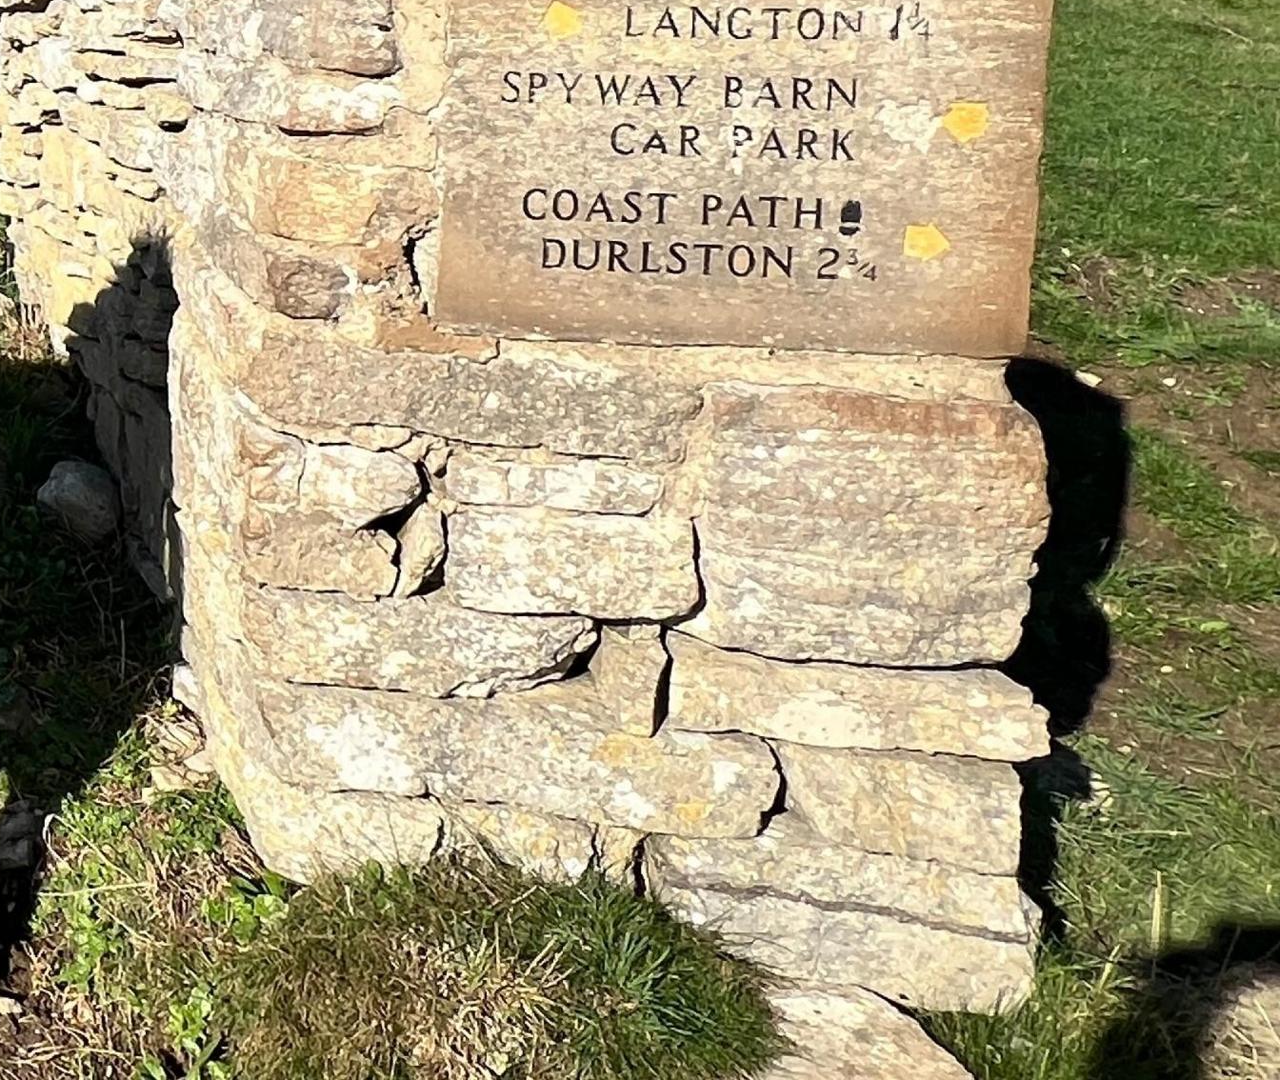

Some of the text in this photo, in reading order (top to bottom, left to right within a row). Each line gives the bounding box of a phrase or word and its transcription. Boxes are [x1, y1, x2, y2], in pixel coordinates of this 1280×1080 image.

[625, 6, 863, 40] LANGTON
[501, 71, 857, 111] SPYWAY BARN
[610, 123, 854, 161] CAR PARK
[522, 188, 823, 230] COAST PATH
[542, 237, 793, 278] DURLSTON
